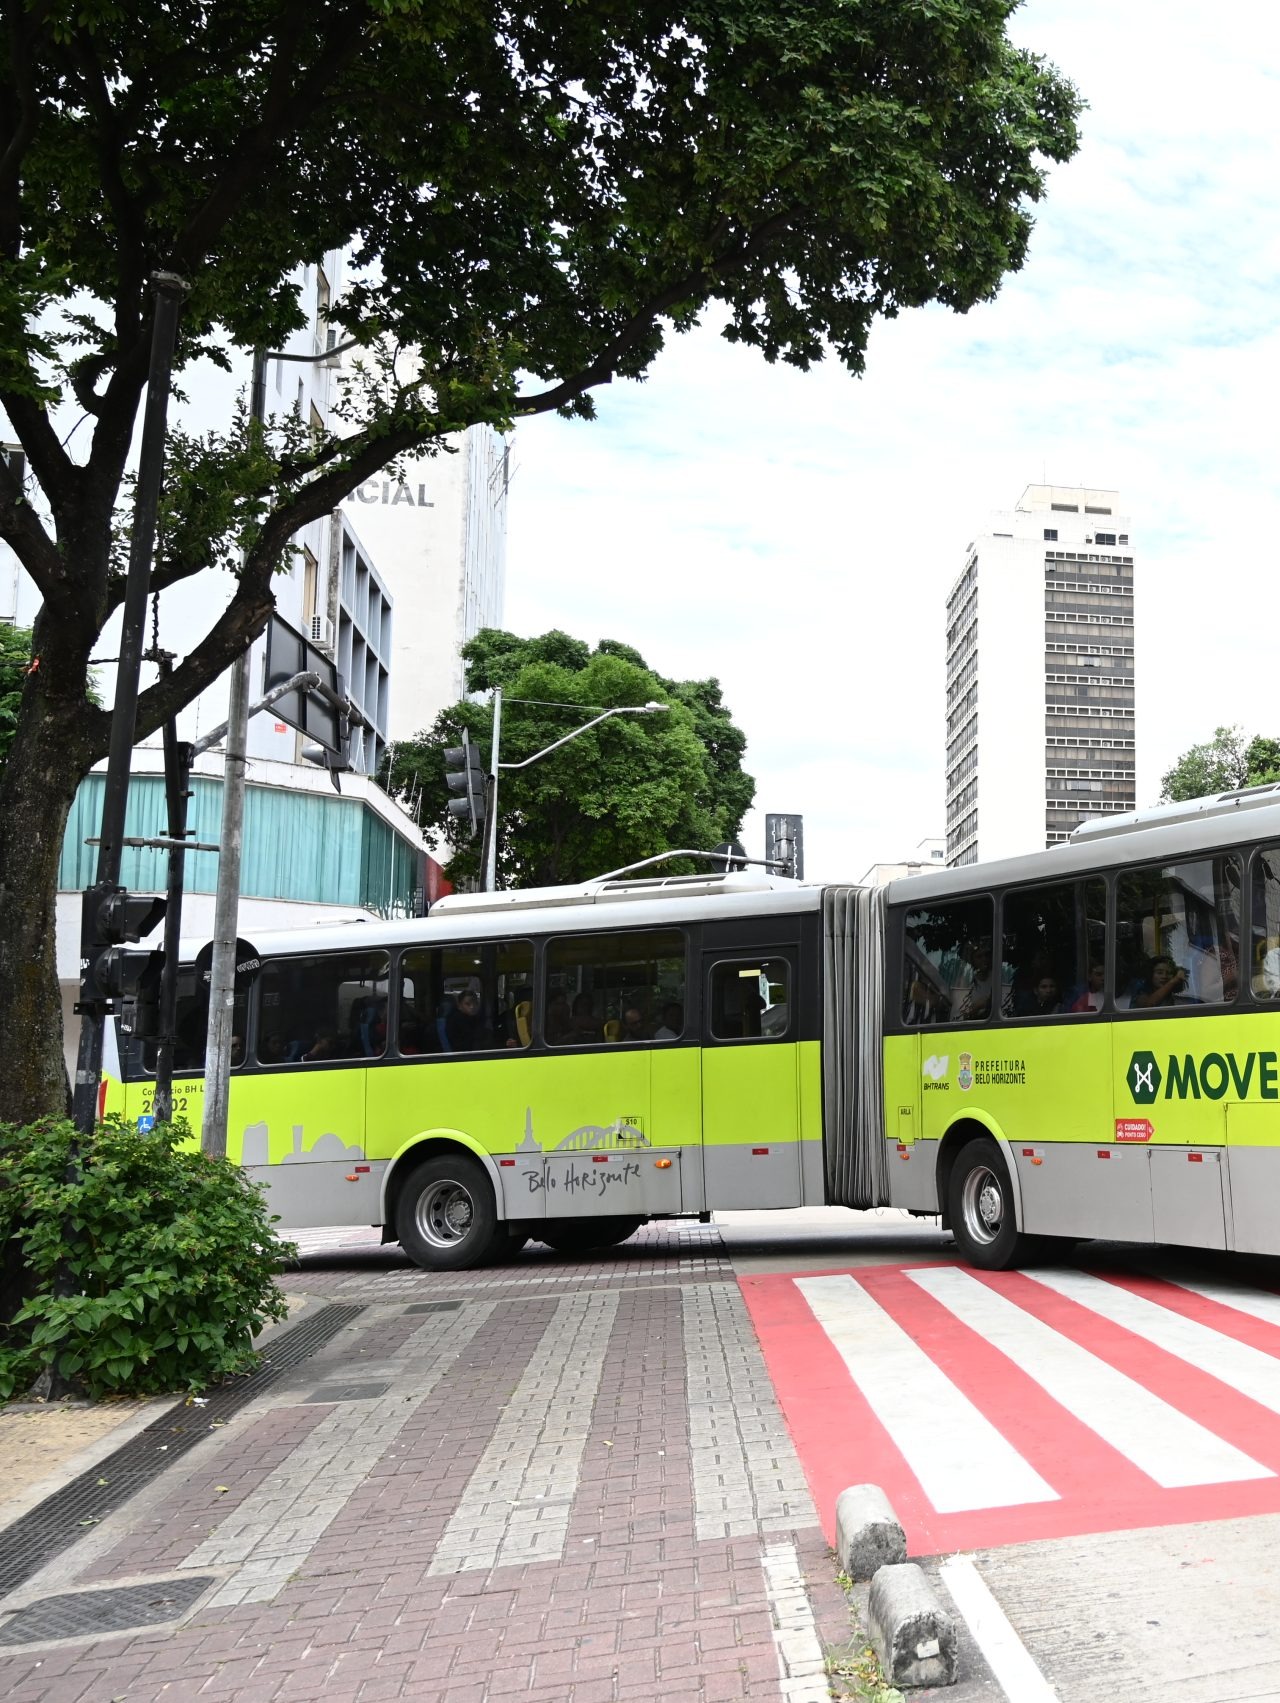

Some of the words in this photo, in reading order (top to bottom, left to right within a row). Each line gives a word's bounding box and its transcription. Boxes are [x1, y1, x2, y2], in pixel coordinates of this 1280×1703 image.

[347, 479, 435, 508] CIAL
[975, 1060, 1026, 1071] PREFEITURA
[975, 1074, 990, 1085] BELO
[991, 1073, 1026, 1084] HORIZONTE
[1164, 1051, 1279, 1100] MOVE
[185, 1085, 197, 1094] BH
[923, 1082, 950, 1090] BHTRANS
[142, 1097, 188, 1114] 202
[1124, 1123, 1147, 1131] CUIDADO!
[522, 1166, 556, 1193] Belo
